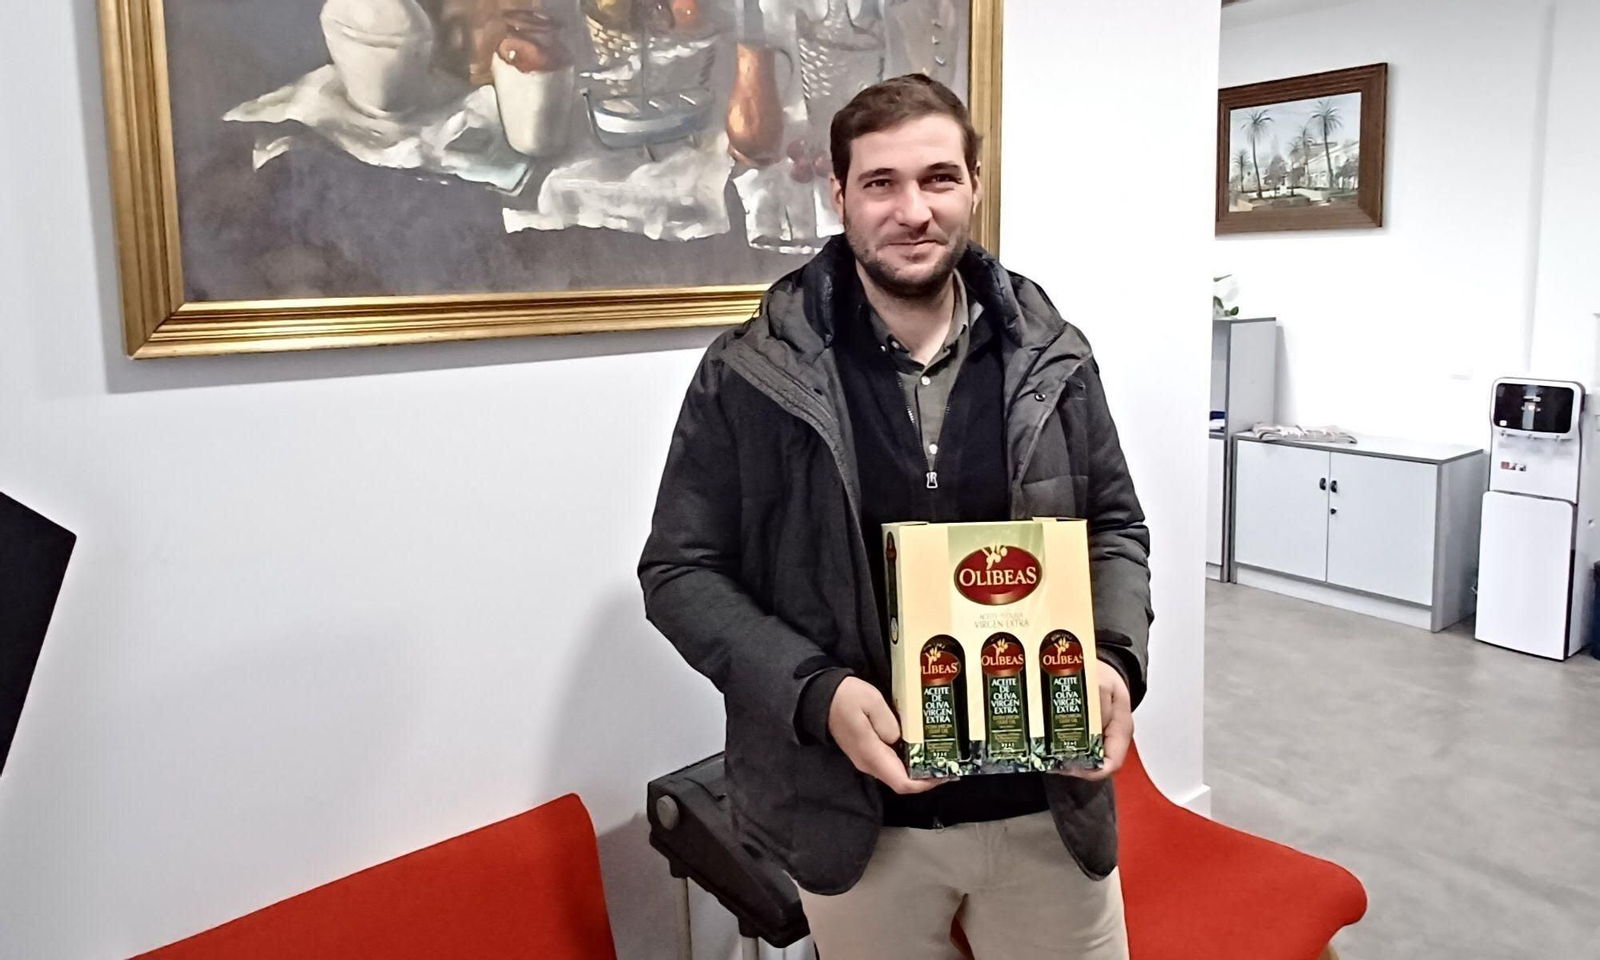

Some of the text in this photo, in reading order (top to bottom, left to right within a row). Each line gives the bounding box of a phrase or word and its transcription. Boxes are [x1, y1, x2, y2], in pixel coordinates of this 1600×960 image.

[959, 566, 1037, 587] OLIBEAS
[974, 620, 1004, 628] VIRGEN
[981, 654, 1024, 666] OLIBEAS
[921, 662, 958, 675] LIBEAS
[991, 678, 1017, 686] ACEITE
[1053, 677, 1078, 685] ACEITE
[924, 686, 950, 695] ACEITE
[999, 685, 1010, 693] DE
[1061, 684, 1071, 692] DE
[931, 694, 942, 702] DE
[993, 692, 1017, 700] OLIVA
[1055, 691, 1078, 699] OLIVA
[925, 701, 949, 709] OLIVA
[991, 699, 1020, 708] VIRGEN
[1053, 698, 1081, 706] VIRGEN
[923, 708, 952, 717] VIRGEN
[994, 706, 1018, 715] EXTRA
[1056, 705, 1080, 714] EXTRA
[926, 716, 951, 724] EXTRA
